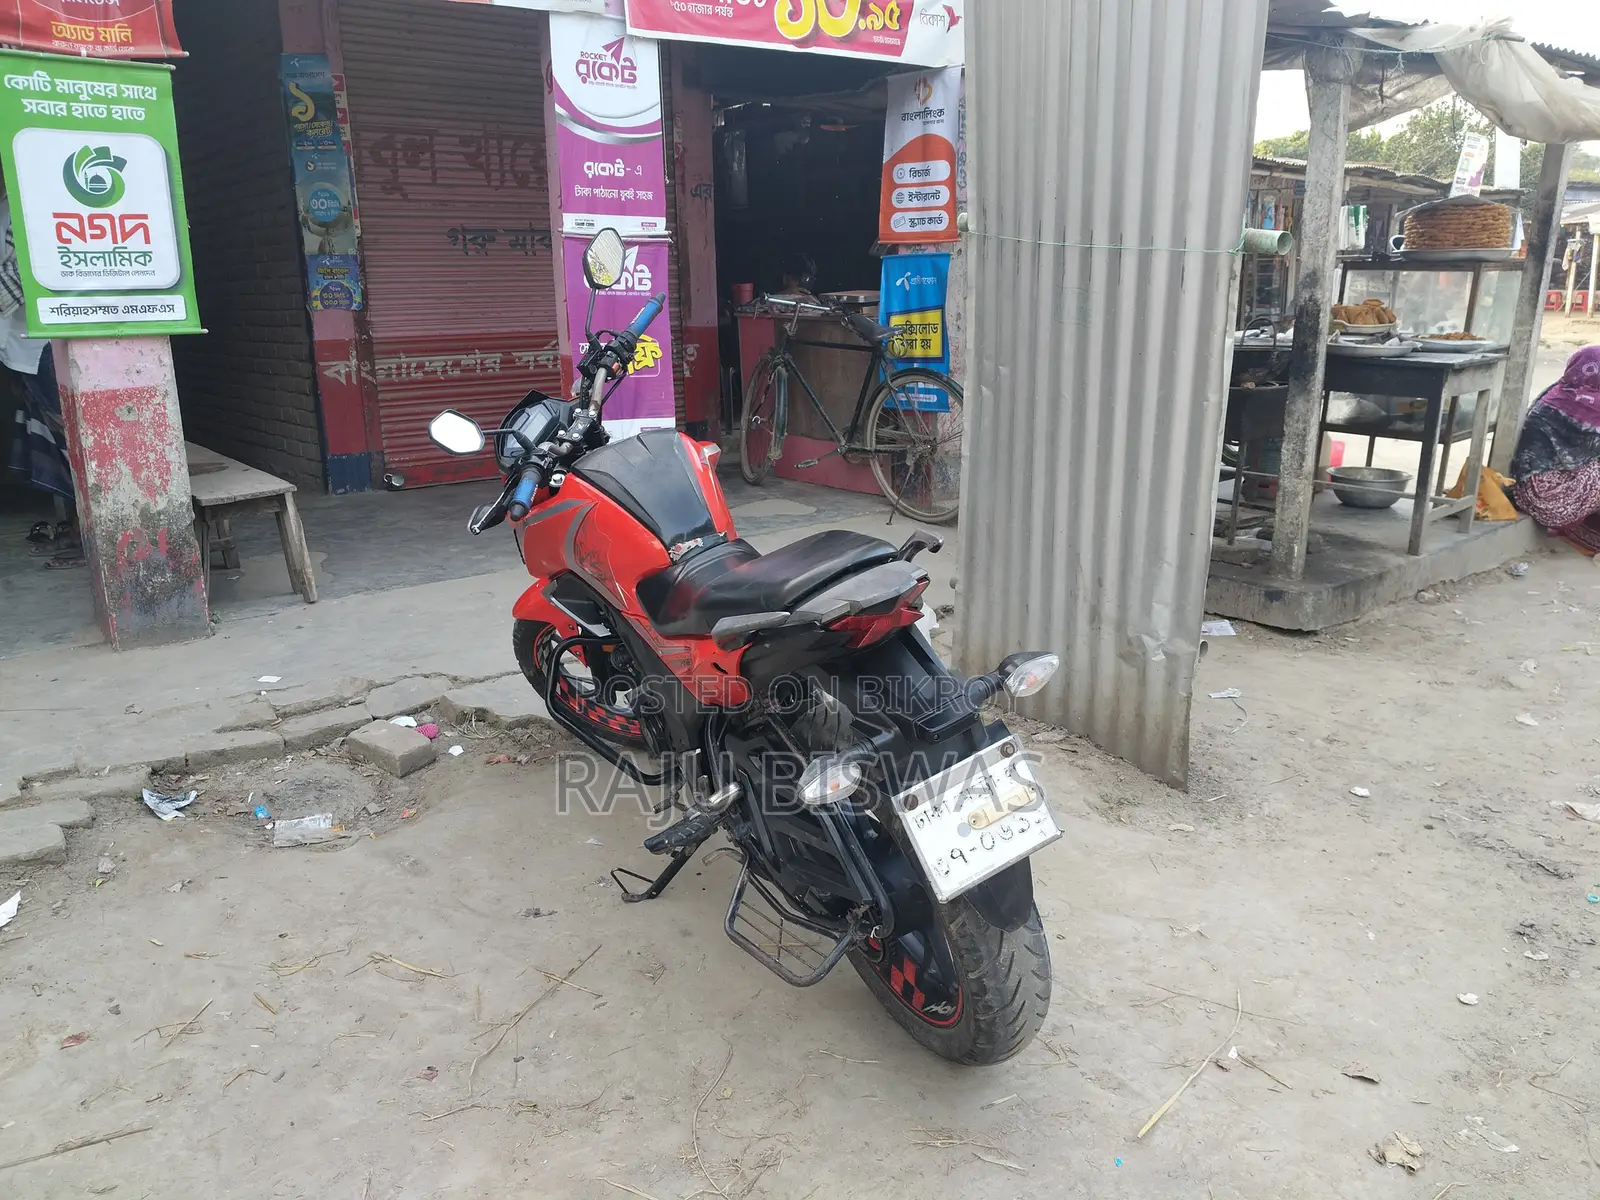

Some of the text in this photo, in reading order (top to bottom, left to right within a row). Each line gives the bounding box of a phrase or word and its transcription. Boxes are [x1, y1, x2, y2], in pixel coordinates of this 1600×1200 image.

[920, 8, 945, 27] বিকাশ
[51, 21, 133, 43] অ্যাড মানি
[580, 51, 608, 61] ROCKET
[575, 56, 638, 84] রকেট
[4, 69, 158, 101] কোটি মানুষের সাথে
[21, 98, 146, 121] সবার হাতে হাতে
[901, 106, 945, 122] বাংলালিংক
[583, 158, 625, 179] রকেট
[908, 165, 931, 180] রিচার্জ
[574, 184, 592, 197] টাকা
[592, 184, 619, 199] পাঠানো
[636, 189, 654, 201] সহজ
[907, 189, 941, 202] ইন্টারনেট
[926, 213, 944, 225] কার্ড
[52, 212, 151, 245] নগদ
[57, 246, 153, 269] ইসলামিক
[121, 303, 175, 315] এমএফএস
[920, 337, 932, 350] হয়
